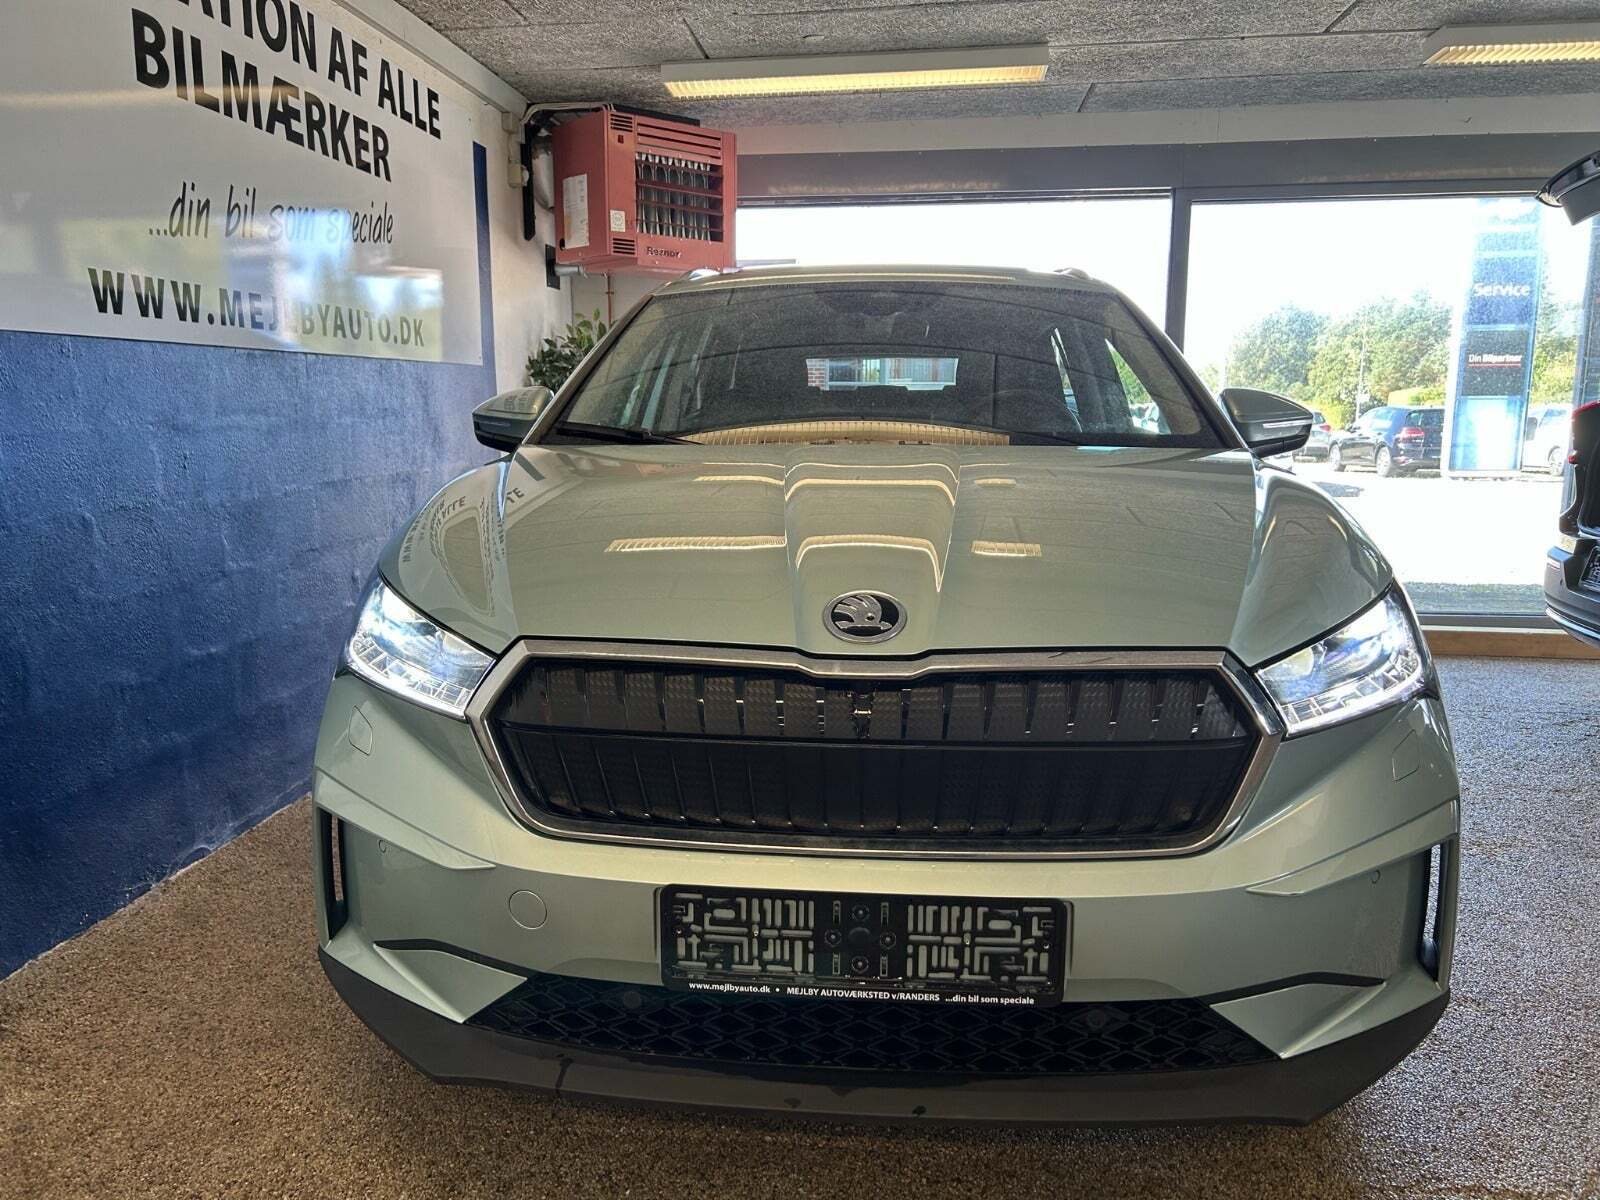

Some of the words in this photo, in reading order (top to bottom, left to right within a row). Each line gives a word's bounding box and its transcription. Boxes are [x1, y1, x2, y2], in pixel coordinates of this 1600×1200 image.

[131, 8, 392, 183] BILMÆRKER
[328, 27, 368, 97] AF
[377, 58, 442, 140] ALLE
[148, 181, 211, 240] ...din
[225, 184, 257, 240] bil
[268, 204, 316, 242] som
[326, 202, 394, 256] speciale
[646, 246, 681, 258] Reznor
[1473, 282, 1530, 298] Service
[1468, 353, 1482, 363] Din
[688, 982, 771, 994] www.mejlbyauto.dk
[786, 986, 819, 996] MEJLBY
[820, 989, 890, 999] AUTOVÆRKSTED
[891, 992, 940, 1001] v/RANDERS
[968, 995, 979, 1003] bil
[980, 996, 999, 1004] som
[1000, 995, 1035, 1006] speciale
